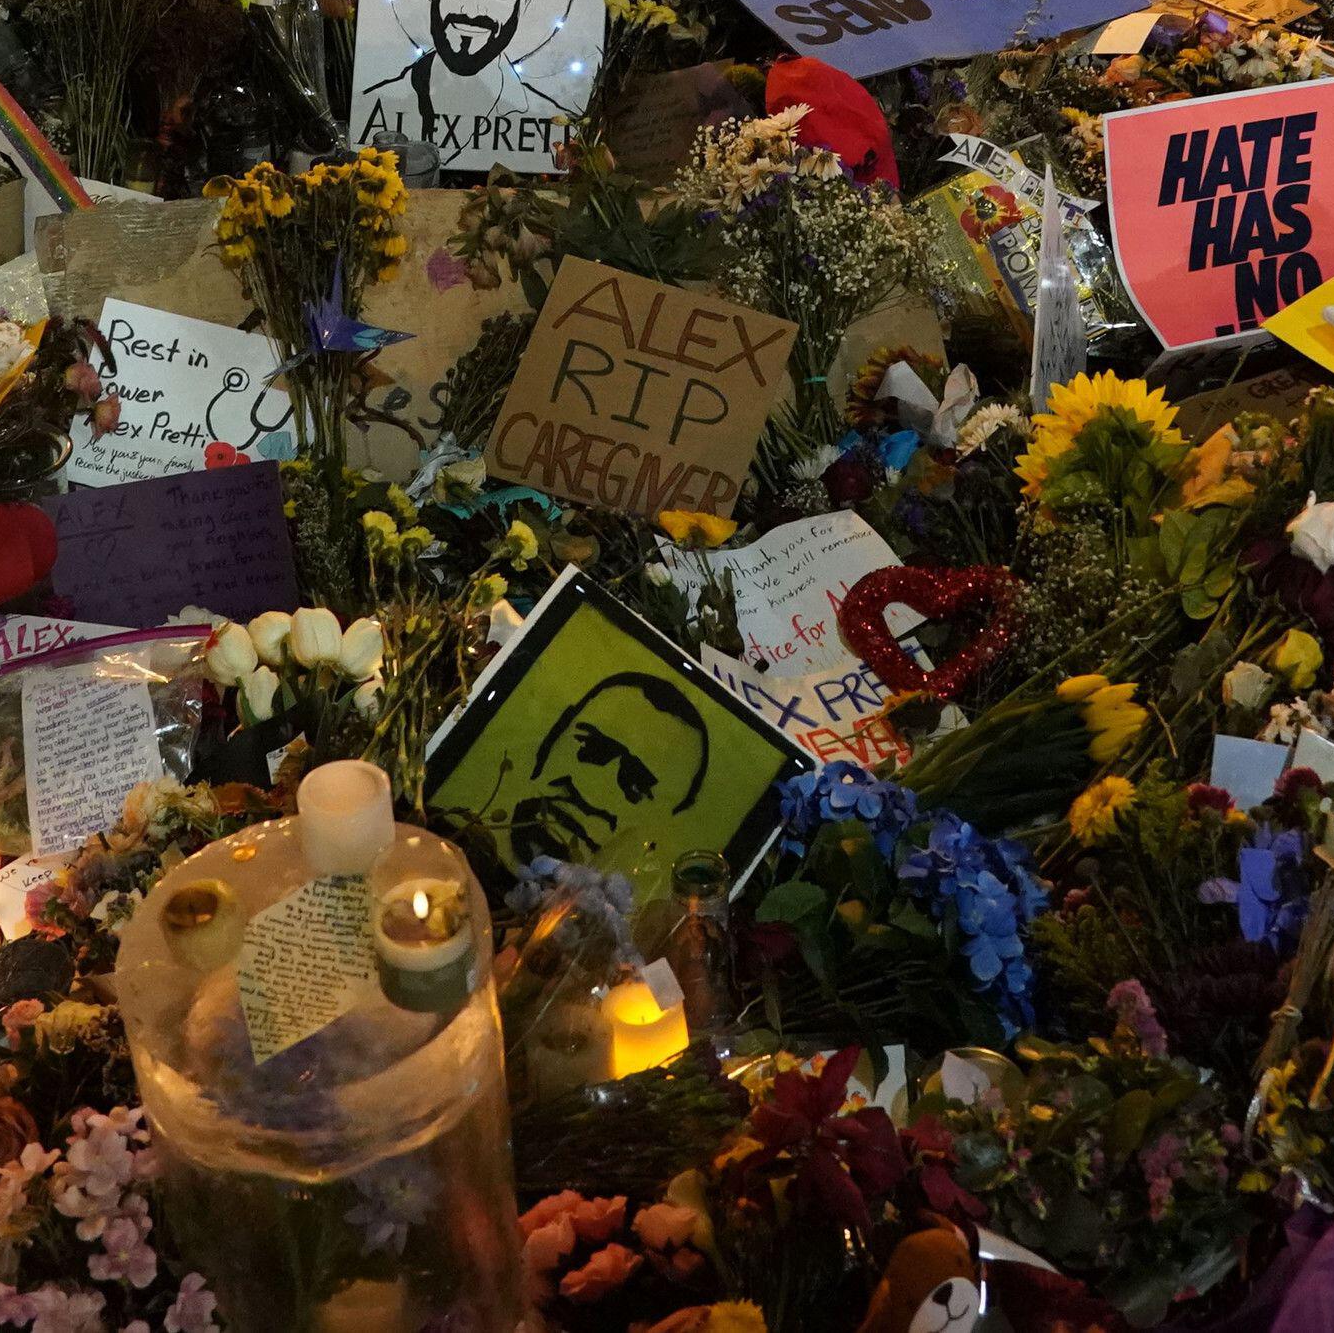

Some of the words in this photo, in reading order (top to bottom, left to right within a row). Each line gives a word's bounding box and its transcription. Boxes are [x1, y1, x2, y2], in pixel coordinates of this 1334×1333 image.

[1157, 111, 1318, 207] HATE
[1187, 183, 1313, 273] HAS
[1234, 251, 1323, 323] NO
[107, 319, 182, 363] Rest
[187, 348, 209, 369] in
[551, 277, 787, 388] ALEX
[549, 338, 730, 446] RIP
[82, 435, 107, 462] May
[148, 410, 211, 449] Pretti
[105, 462, 120, 475] the
[494, 411, 738, 516] CAREGIVER
[728, 547, 778, 582] thank
[781, 535, 809, 560] you
[810, 525, 835, 539] for
[752, 577, 783, 593] We
[787, 550, 817, 576] will
[820, 529, 874, 554] remember
[766, 574, 818, 609] kindness
[791, 613, 828, 648] for
